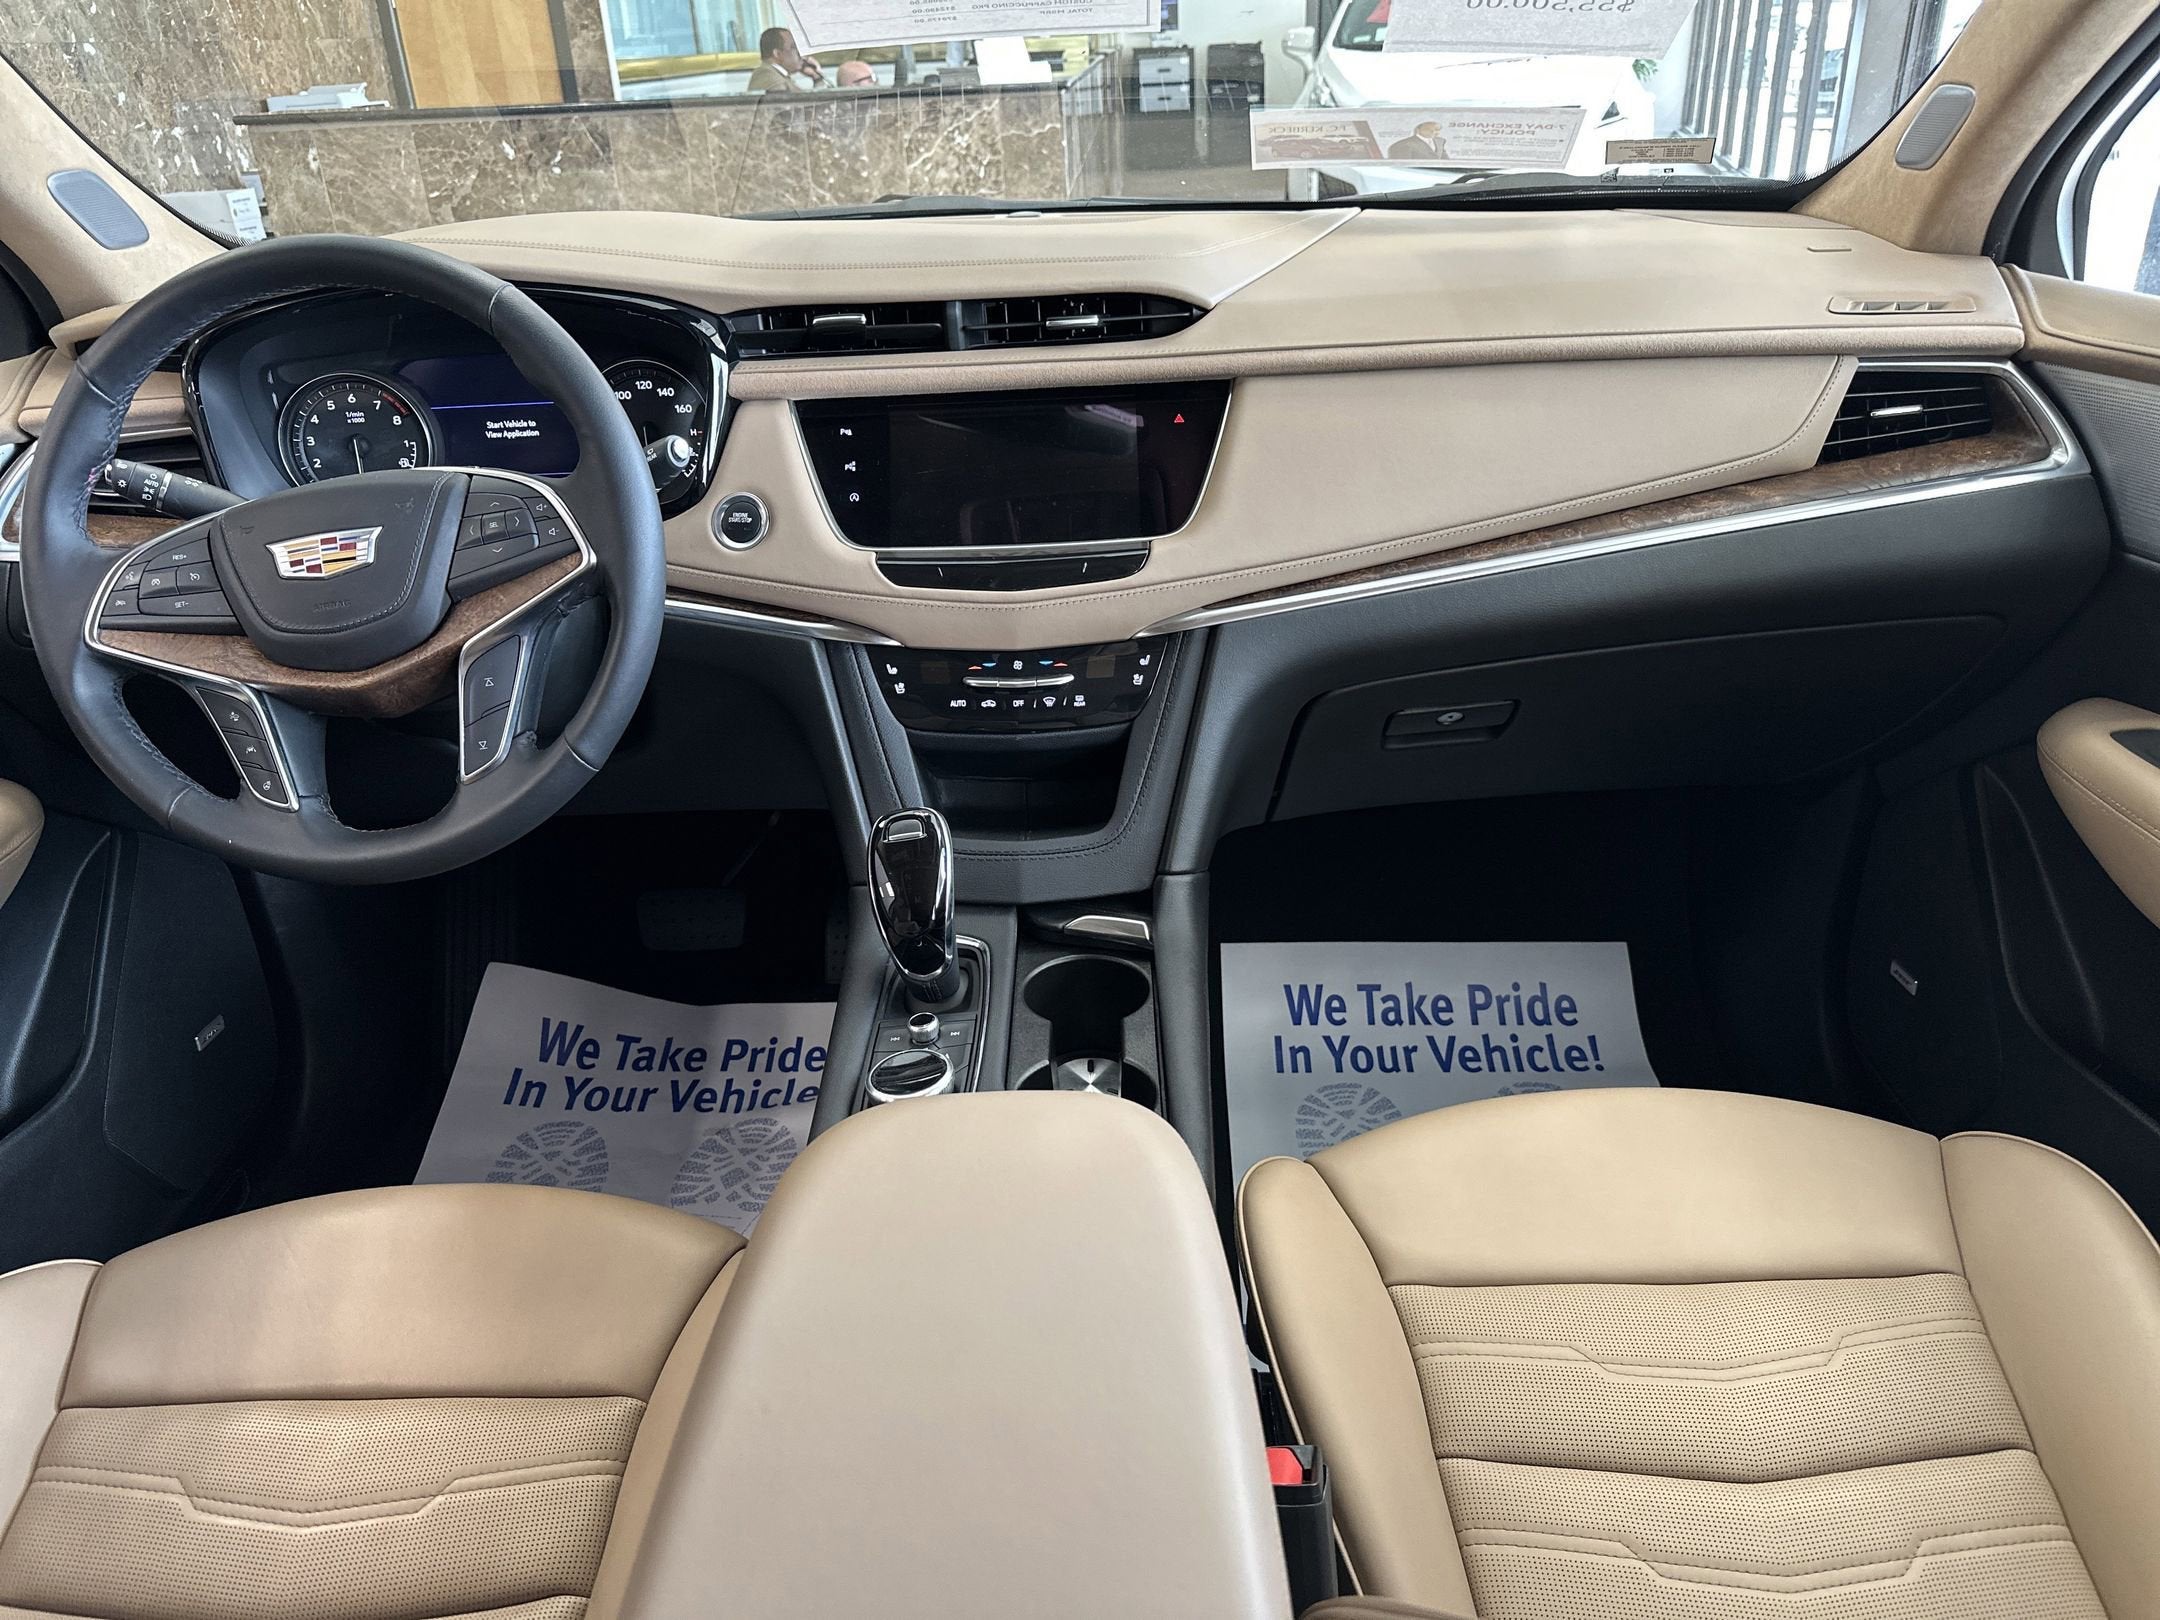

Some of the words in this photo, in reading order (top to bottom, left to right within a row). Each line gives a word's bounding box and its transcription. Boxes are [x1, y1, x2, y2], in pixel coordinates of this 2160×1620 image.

[635, 380, 653, 390] 120
[615, 390, 632, 400] 100
[656, 387, 675, 397] 140
[347, 393, 356, 404] 6
[326, 400, 336, 411] 5
[373, 400, 381, 410] 7
[674, 404, 692, 414] 160
[310, 414, 319, 425] 4
[392, 415, 402, 426] 8
[486, 420, 504, 429] Start
[503, 419, 528, 428] Vehicle
[528, 419, 537, 427] to
[485, 430, 503, 439] View
[502, 429, 540, 440] Application
[689, 428, 697, 436] H
[306, 436, 316, 446] 3
[403, 440, 409, 448] 1
[312, 458, 322, 468] 2
[143, 478, 159, 488] AUTO
[950, 699, 967, 708] AUTO
[1012, 699, 1025, 708] OFF
[1283, 982, 1348, 1027] We
[1356, 980, 1455, 1028] Take
[1467, 980, 1580, 1027] Pride
[538, 1016, 601, 1071] We
[615, 1033, 708, 1073] Take
[720, 1036, 828, 1074] Pride
[1274, 1034, 1313, 1074] In
[1322, 1034, 1418, 1075] Your
[1426, 1032, 1606, 1074] Vehicle!
[502, 1067, 548, 1110] In
[564, 1075, 659, 1113] Your
